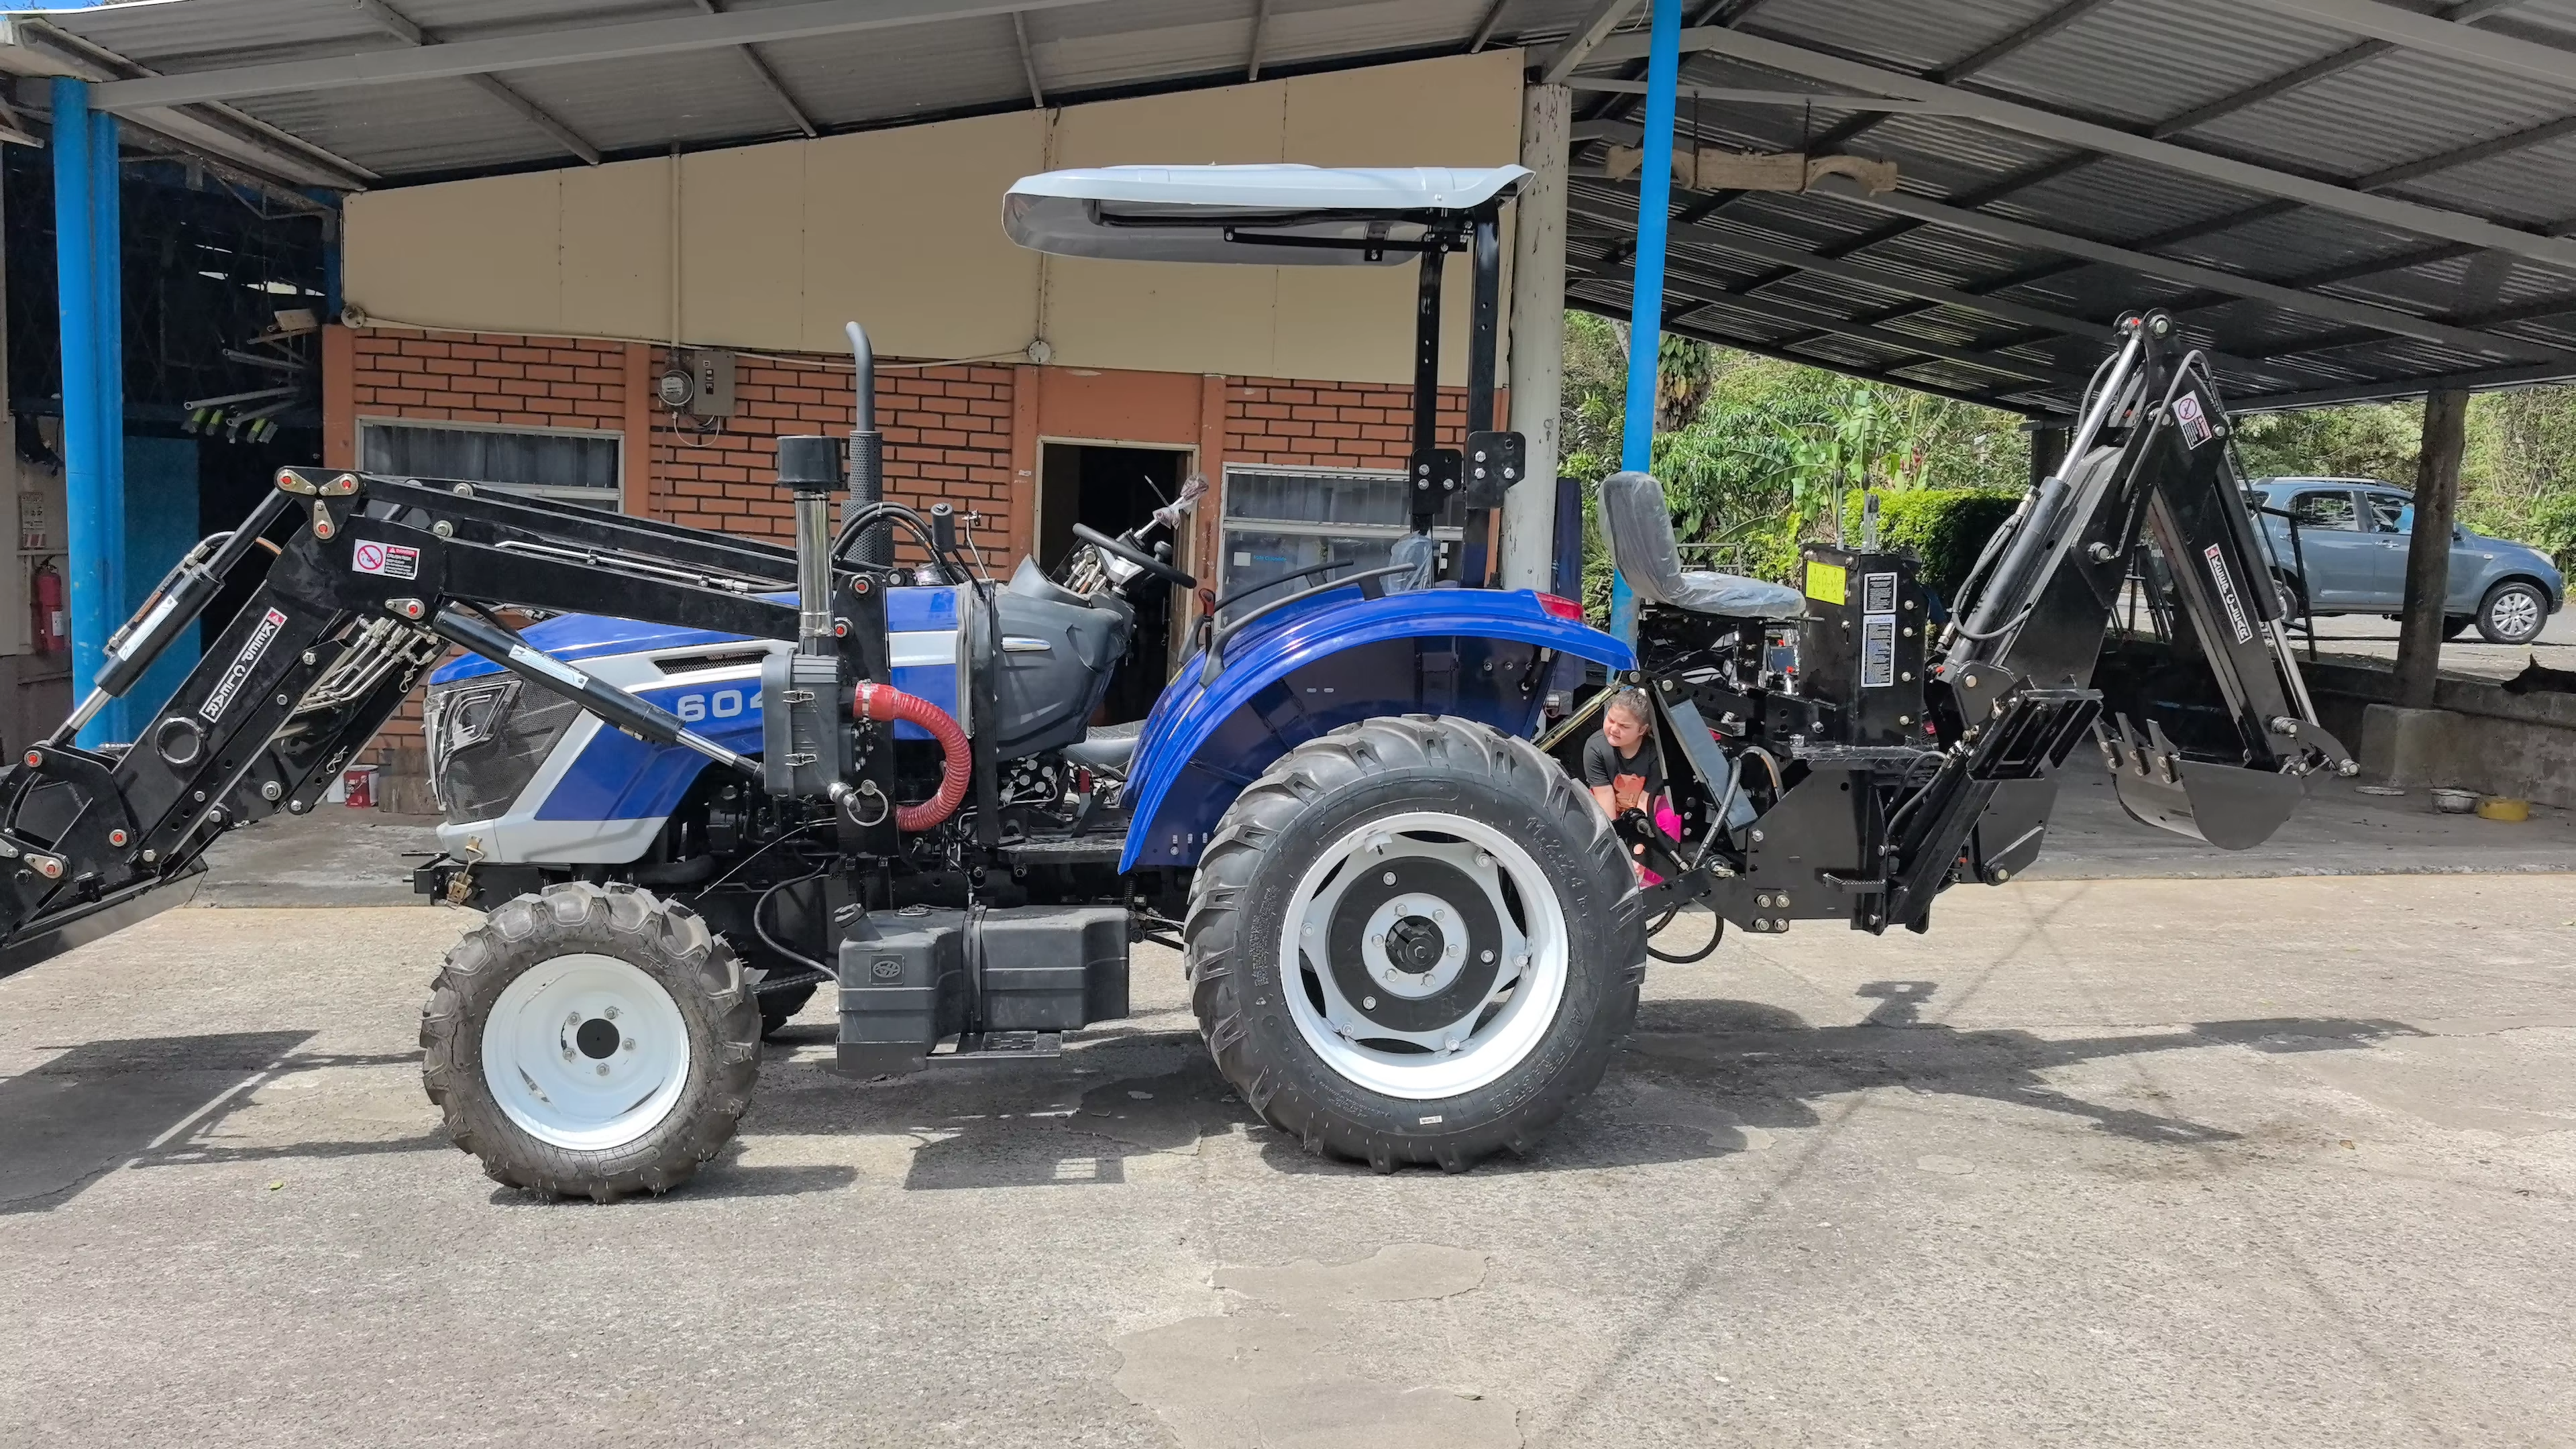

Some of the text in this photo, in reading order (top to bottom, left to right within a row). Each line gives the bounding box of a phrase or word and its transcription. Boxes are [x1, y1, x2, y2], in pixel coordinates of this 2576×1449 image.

[2211, 555, 2248, 639] KEEP CLEAR
[205, 621, 275, 716] KEEP CLEAR
